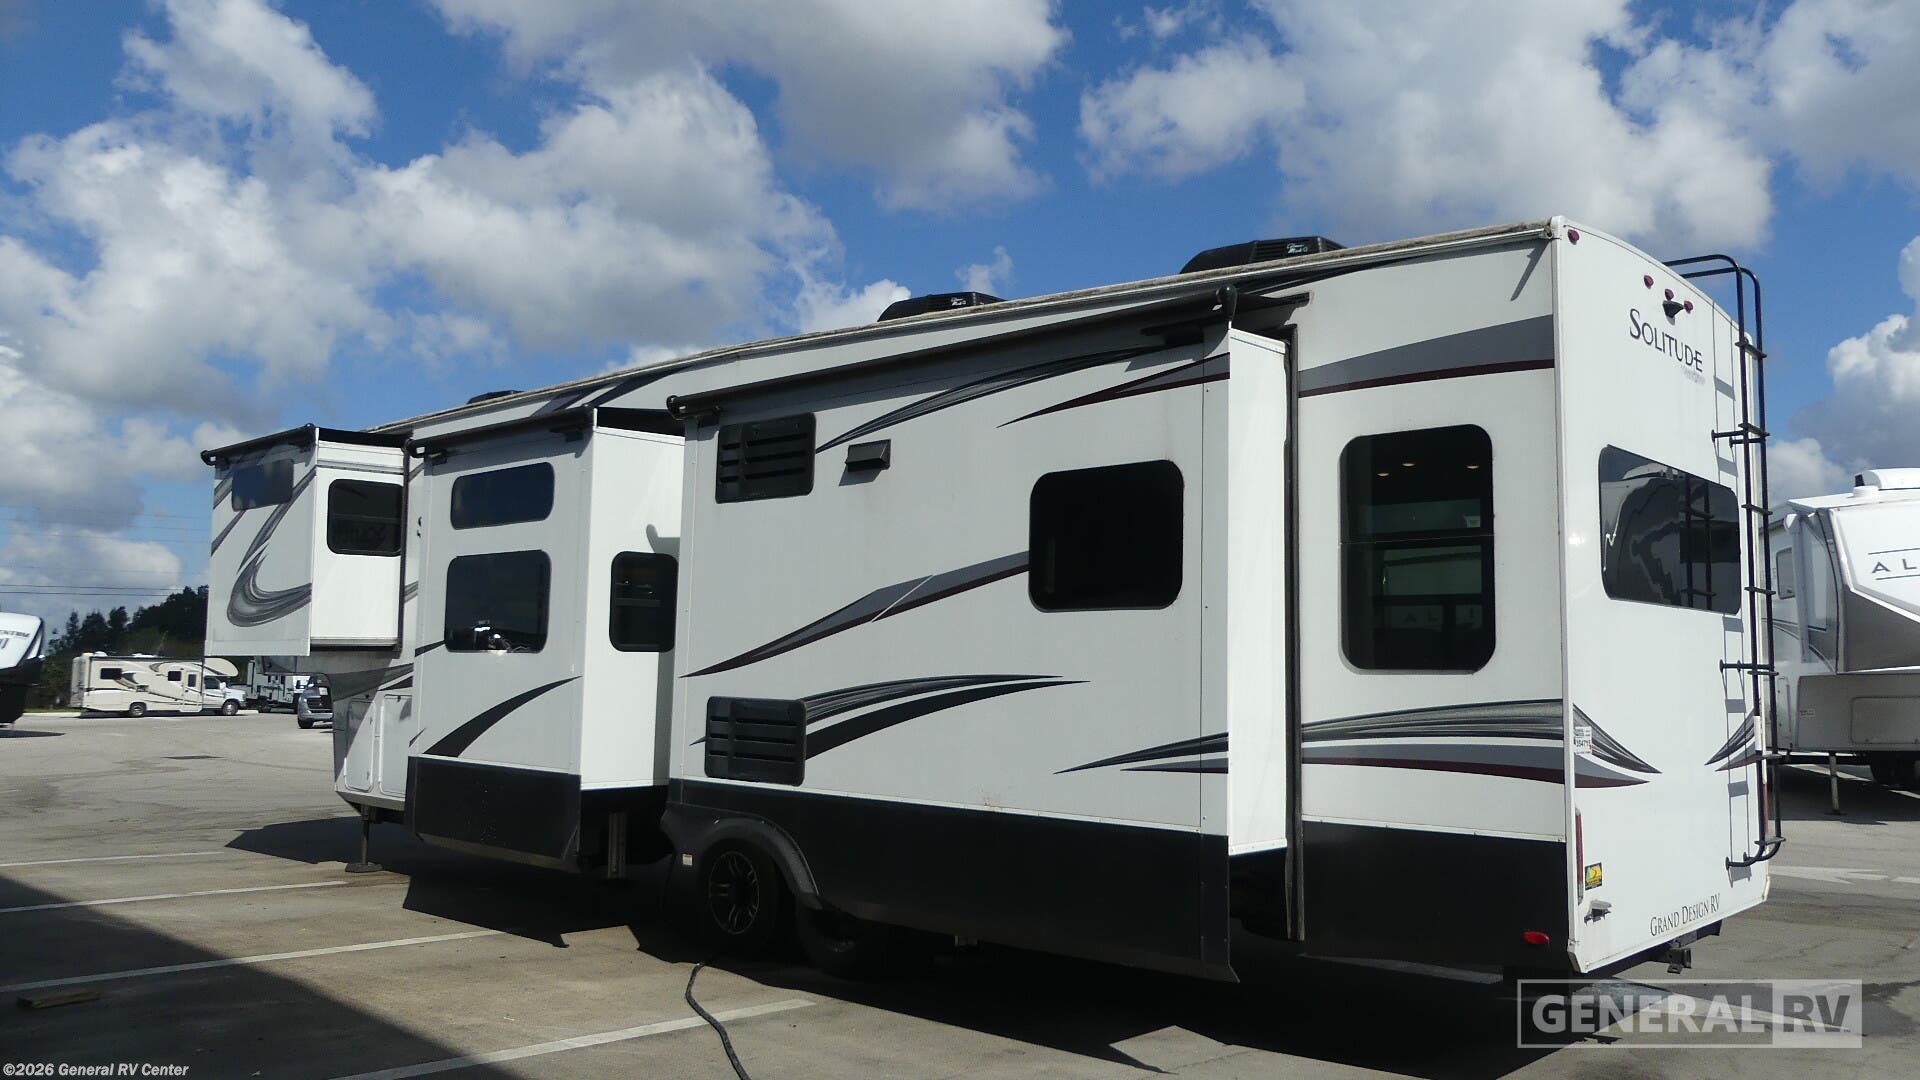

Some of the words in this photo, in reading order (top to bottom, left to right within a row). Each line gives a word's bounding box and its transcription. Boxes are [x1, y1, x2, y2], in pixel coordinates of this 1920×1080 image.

[1629, 308, 1703, 373] SOLITUDE
[1650, 911, 1680, 937] GRAND
[1681, 899, 1709, 925] DESIGN
[1710, 892, 1721, 914] RV
